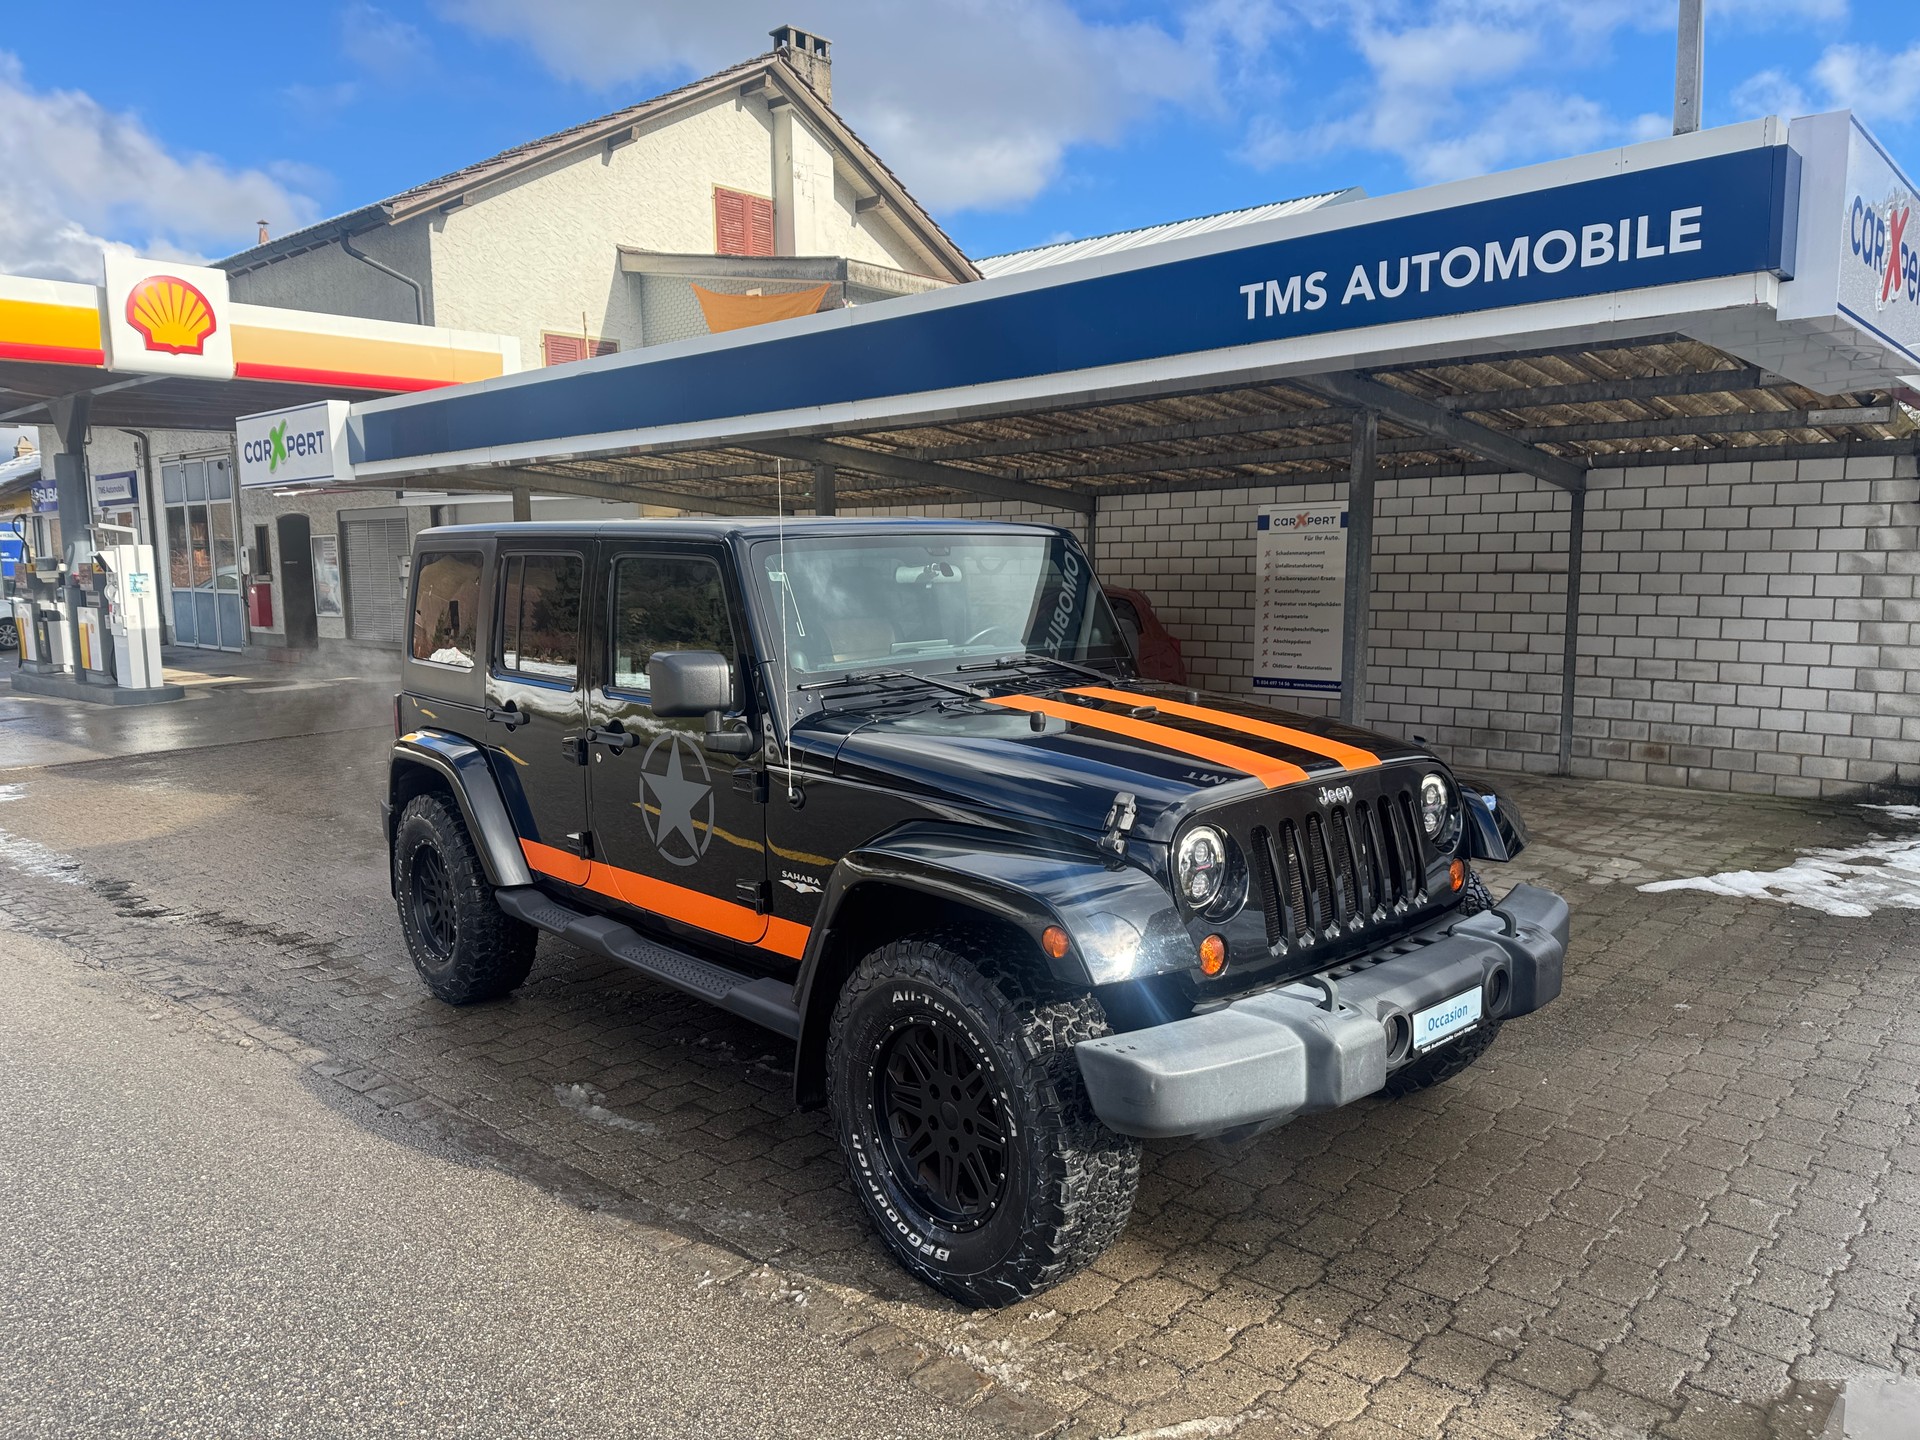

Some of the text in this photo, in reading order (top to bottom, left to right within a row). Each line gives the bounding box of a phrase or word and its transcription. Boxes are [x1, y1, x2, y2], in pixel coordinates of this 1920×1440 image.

[1240, 206, 1702, 319] TMS AUTOMOBILE
[1318, 785, 1353, 805] Jeep
[781, 870, 821, 886] SAHARA
[892, 990, 995, 1072] All-Terrain
[1428, 1005, 1468, 1031] Occasion
